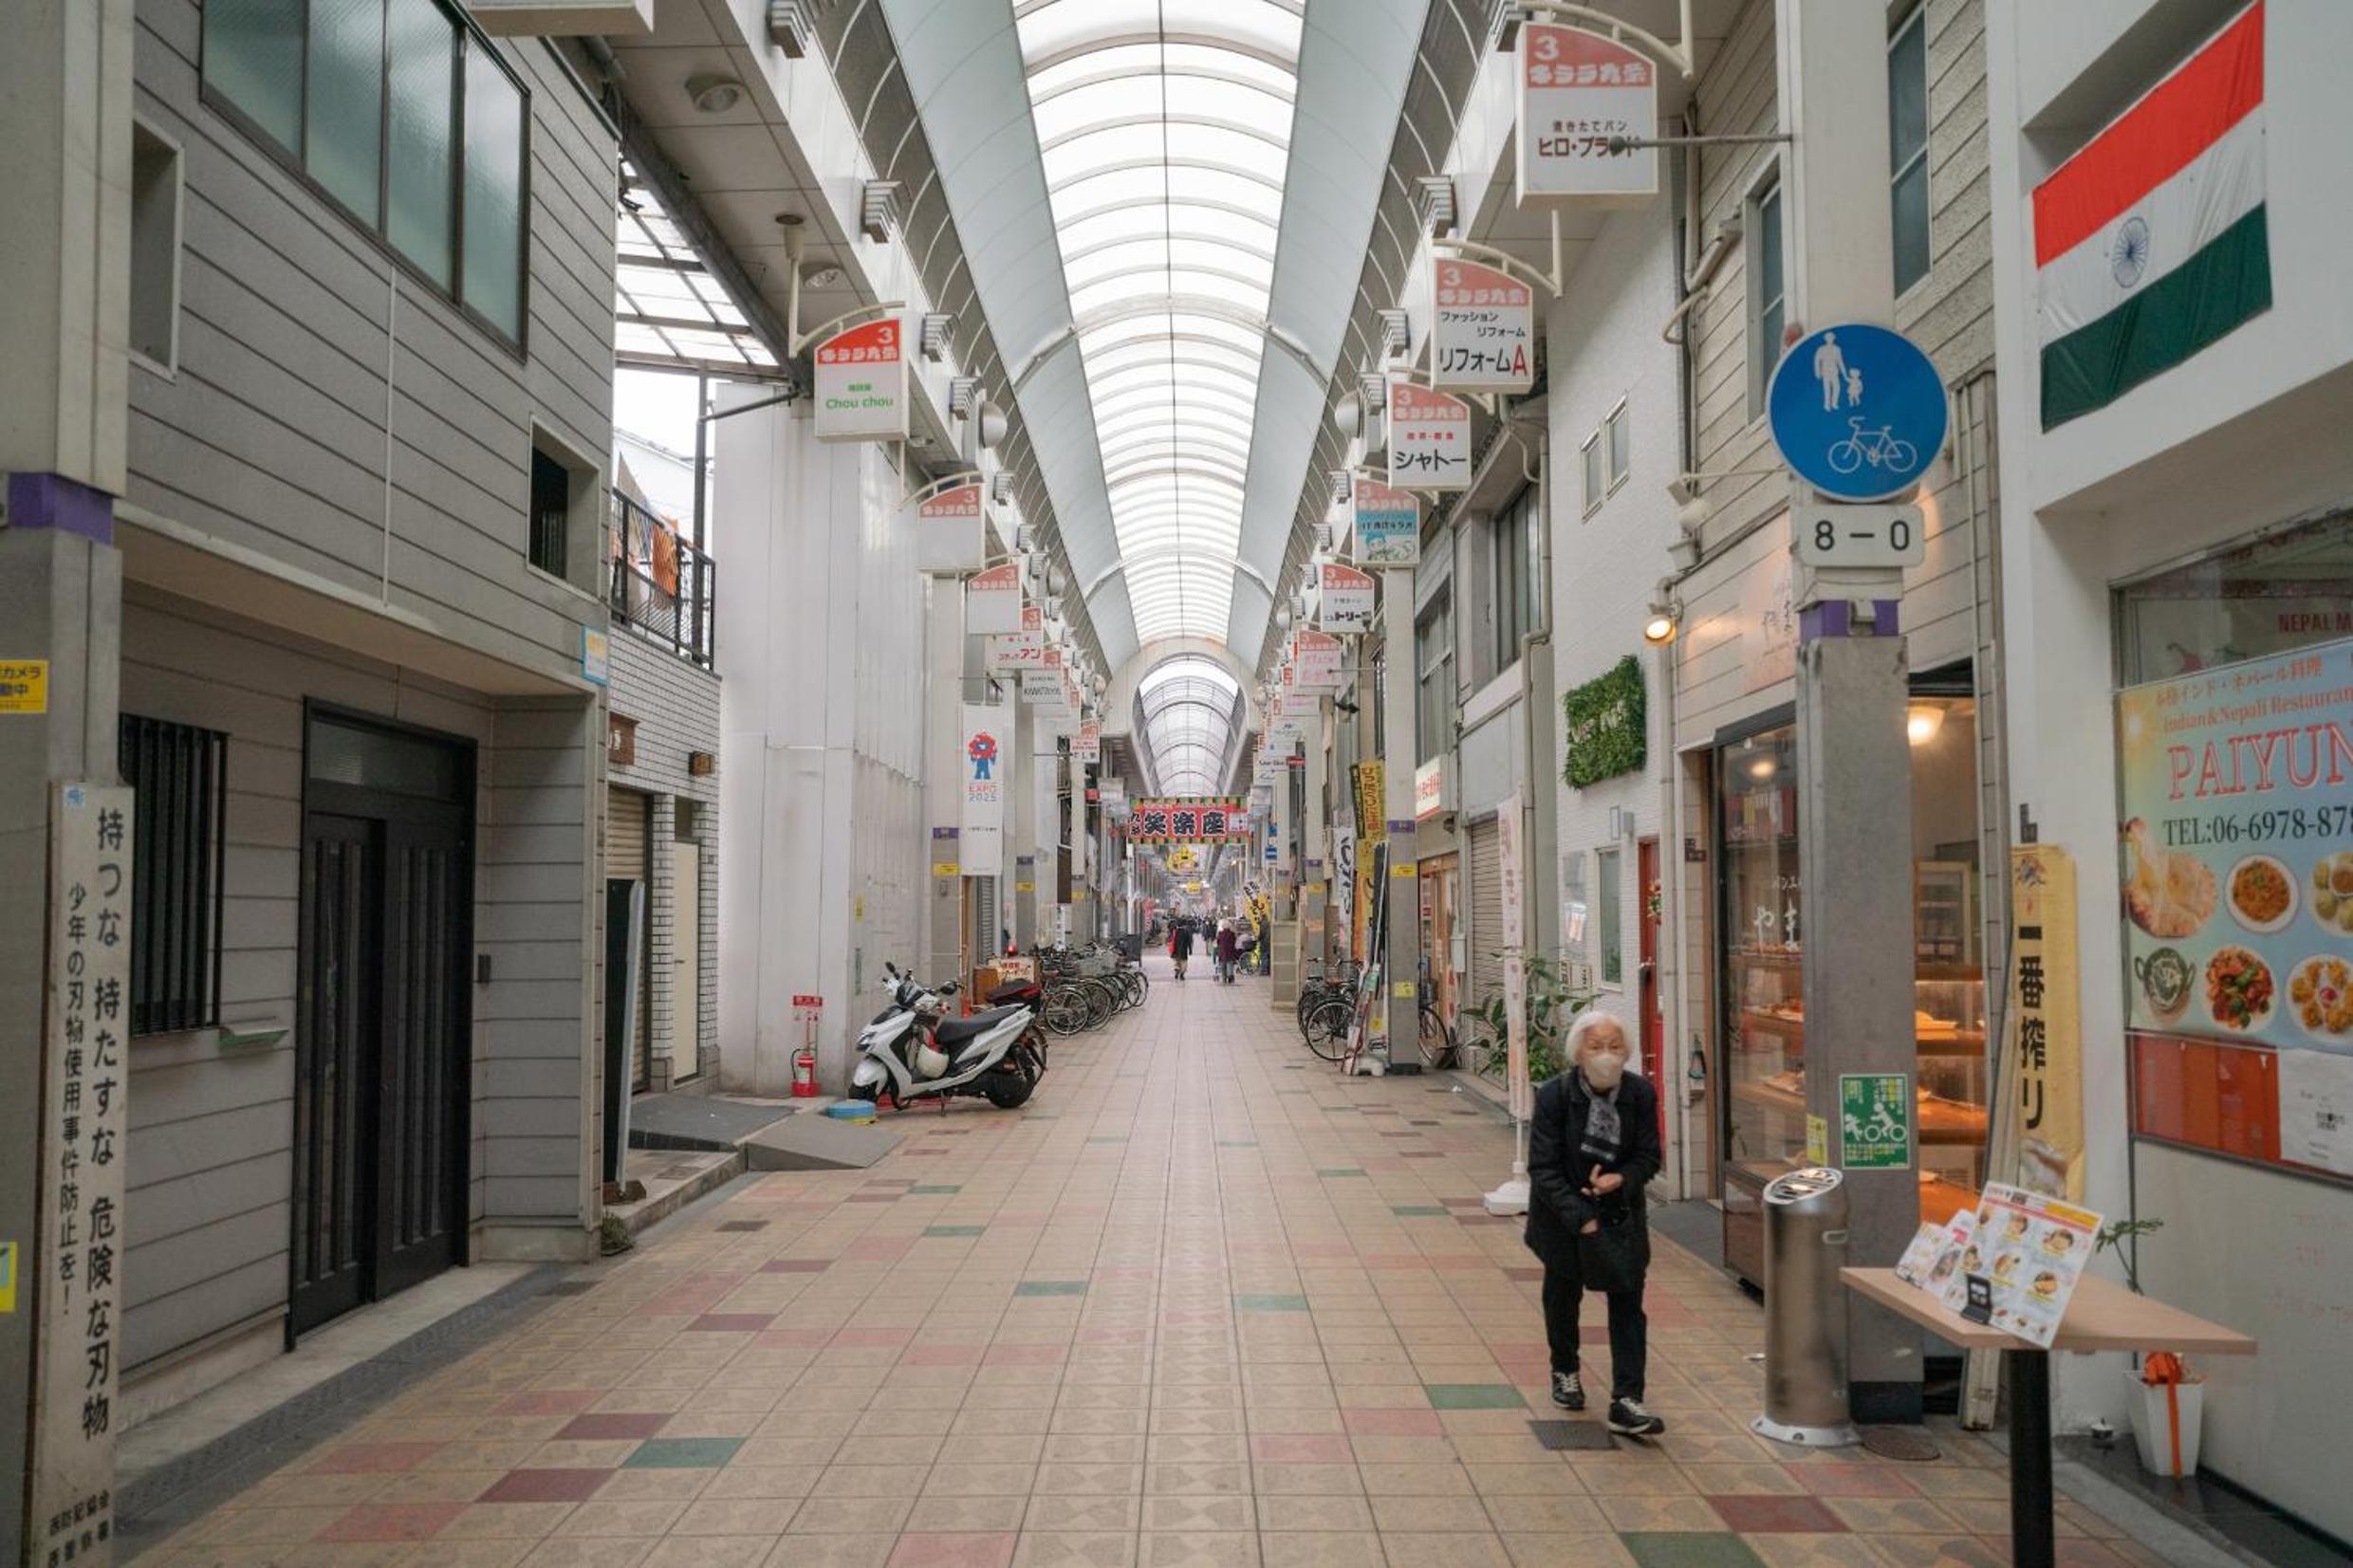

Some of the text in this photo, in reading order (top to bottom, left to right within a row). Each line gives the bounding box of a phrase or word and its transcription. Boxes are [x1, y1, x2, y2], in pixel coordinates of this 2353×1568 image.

[1535, 36, 1558, 60] 3
[1444, 268, 1462, 286] 3
[1440, 311, 1499, 322] ファッション
[879, 327, 895, 344] 3
[1476, 327, 1526, 338] リフォーム
[1398, 390, 1411, 405] 3
[1395, 449, 1467, 471] シャトー
[964, 490, 976, 503] 3
[2277, 612, 2330, 633] NEPAL
[969, 784, 996, 793] EXPO
[969, 793, 996, 802] 2025
[2162, 804, 2353, 846] TEL:06-6978-87
[2018, 925, 2047, 1131] 一番搾り
[82, 806, 123, 1441] 持つな 持たすな 危険な刃物
